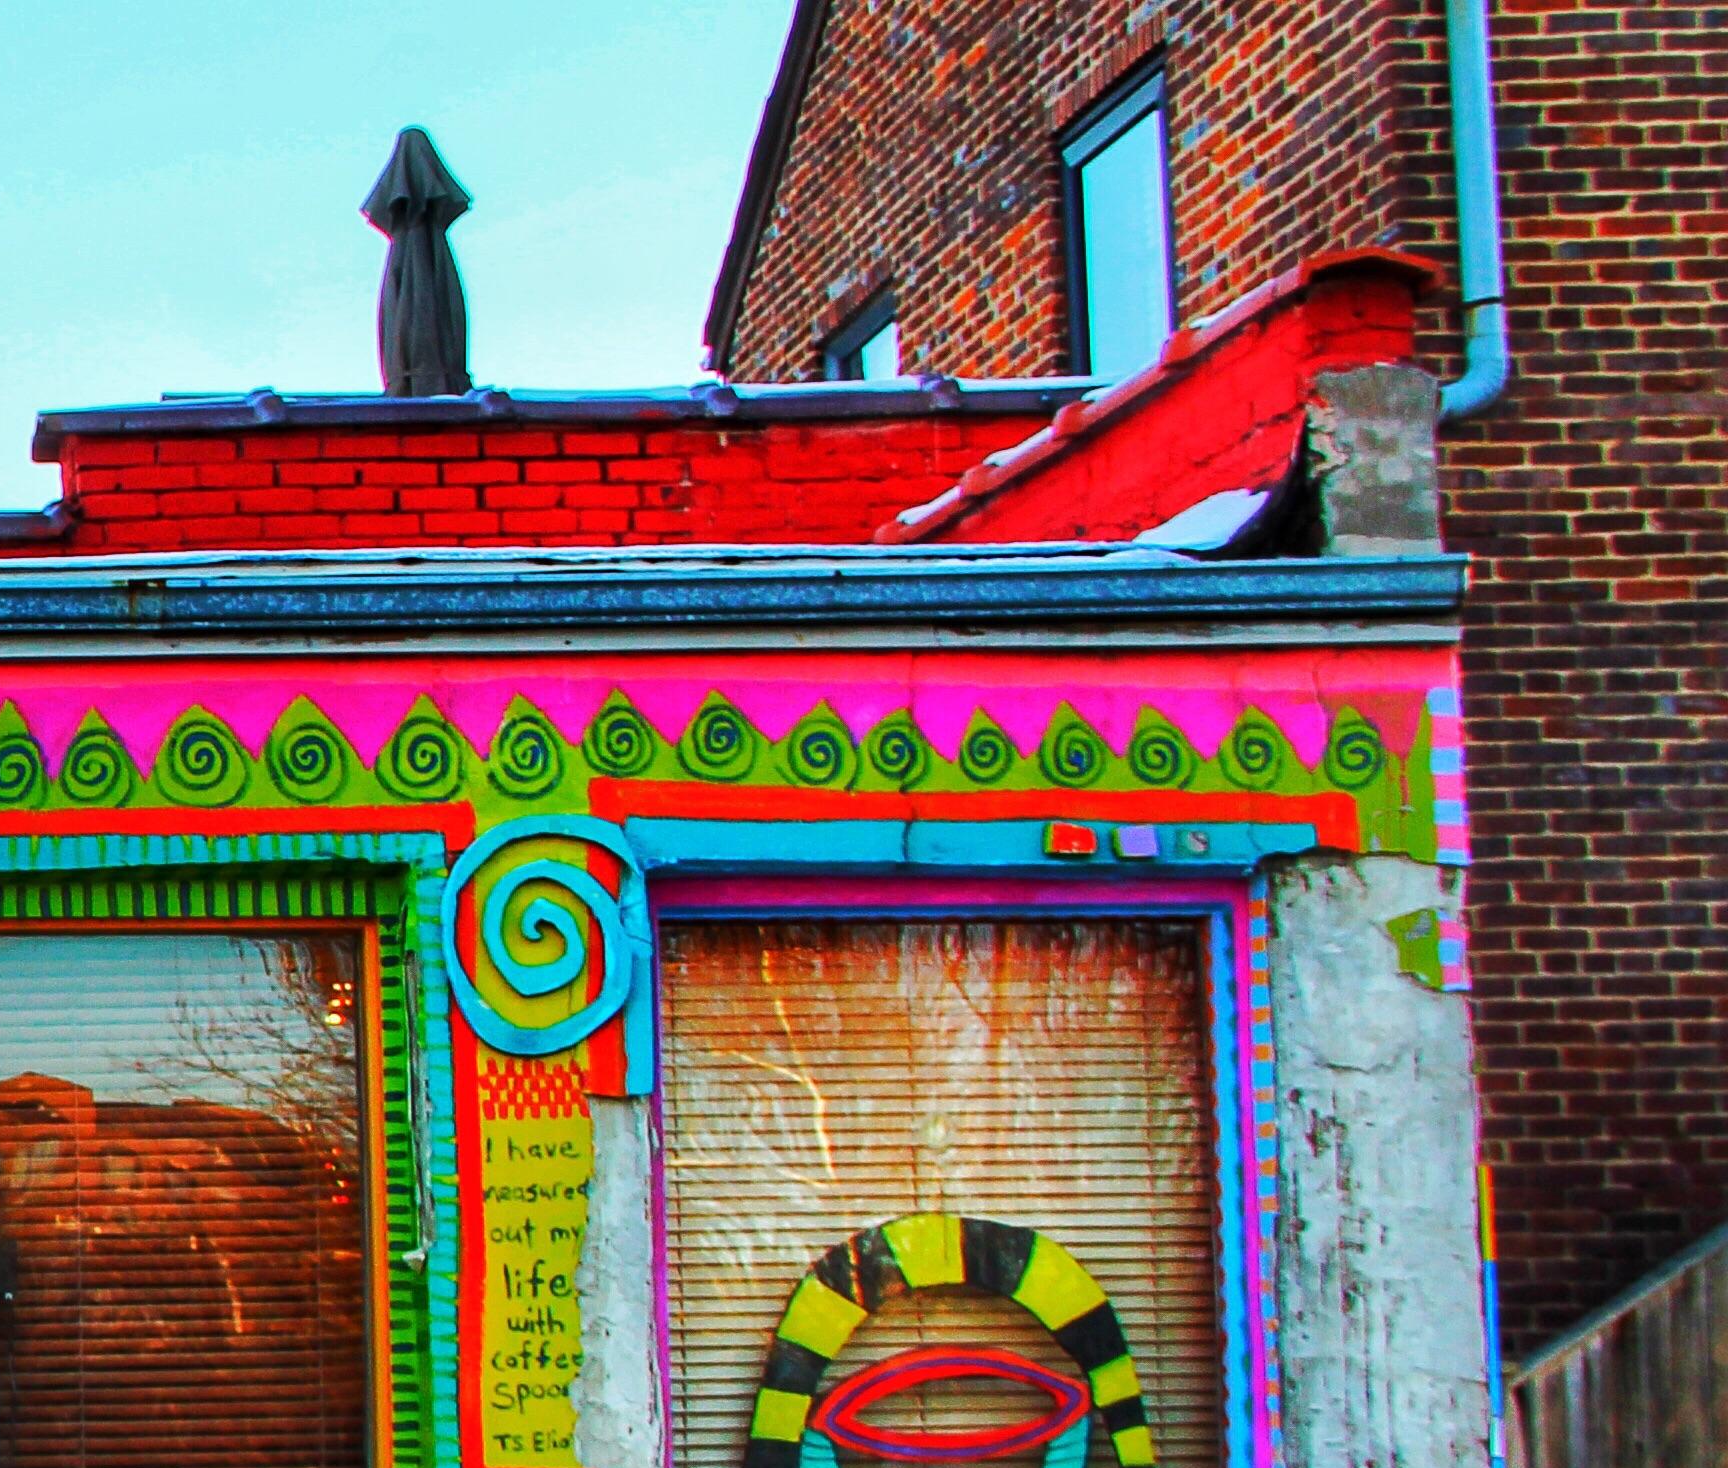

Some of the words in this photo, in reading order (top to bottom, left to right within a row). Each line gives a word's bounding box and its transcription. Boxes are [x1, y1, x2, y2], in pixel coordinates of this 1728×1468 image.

[485, 1137, 493, 1163] I
[508, 1136, 581, 1162] have
[490, 1216, 537, 1249] out
[550, 1226, 582, 1257] my
[503, 1258, 573, 1300] life
[506, 1306, 565, 1335] with
[491, 1340, 585, 1372] coffee
[493, 1433, 525, 1453] TS
[532, 1428, 574, 1453] Elio
